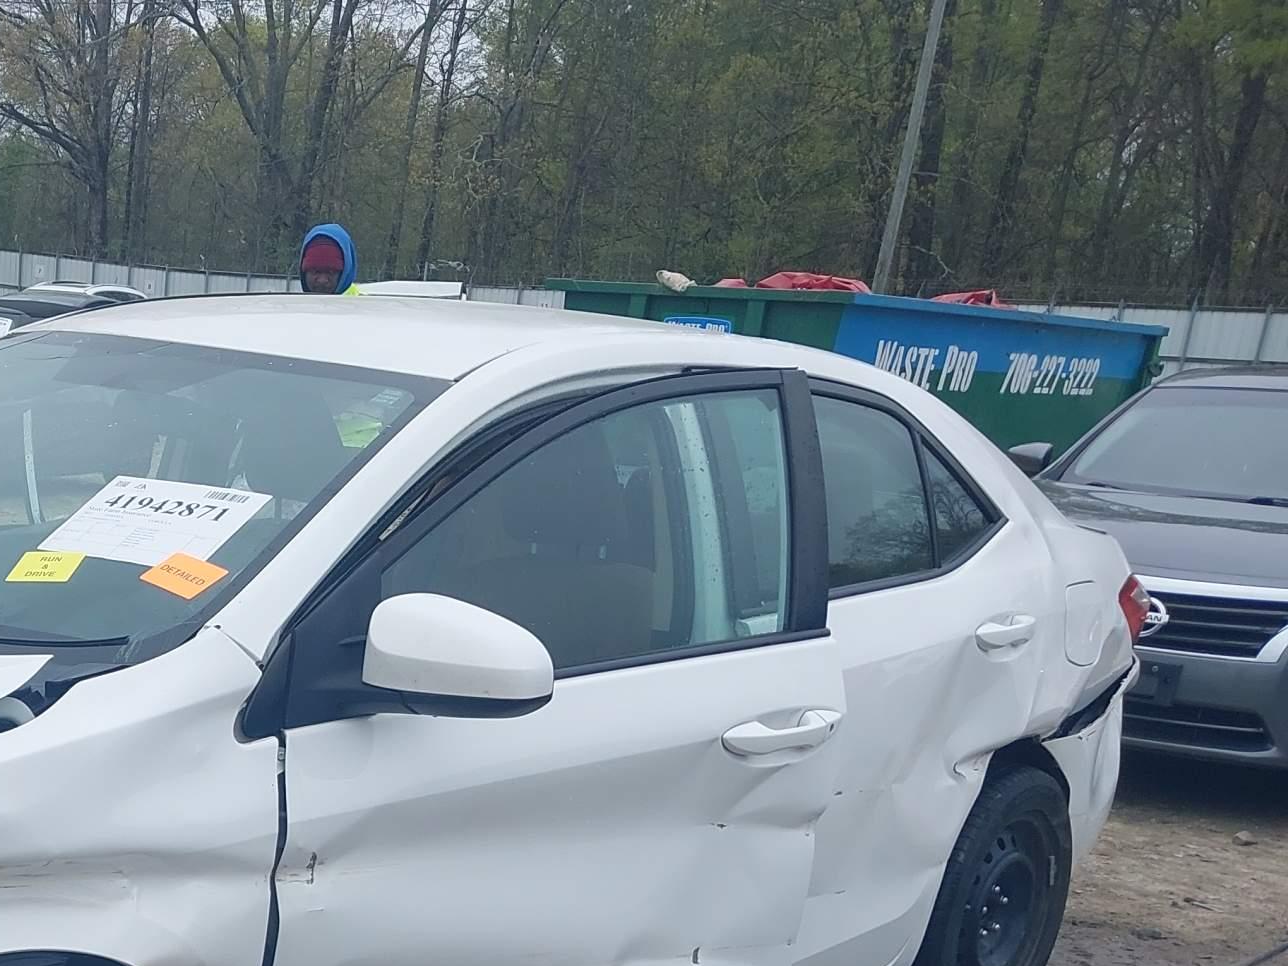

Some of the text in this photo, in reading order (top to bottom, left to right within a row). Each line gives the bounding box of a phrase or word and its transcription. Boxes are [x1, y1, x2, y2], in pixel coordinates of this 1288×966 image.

[875, 339, 1101, 396] WASTE PRO 706-227-3222
[104, 494, 230, 521] 41942871
[160, 564, 206, 586] DETAILED
